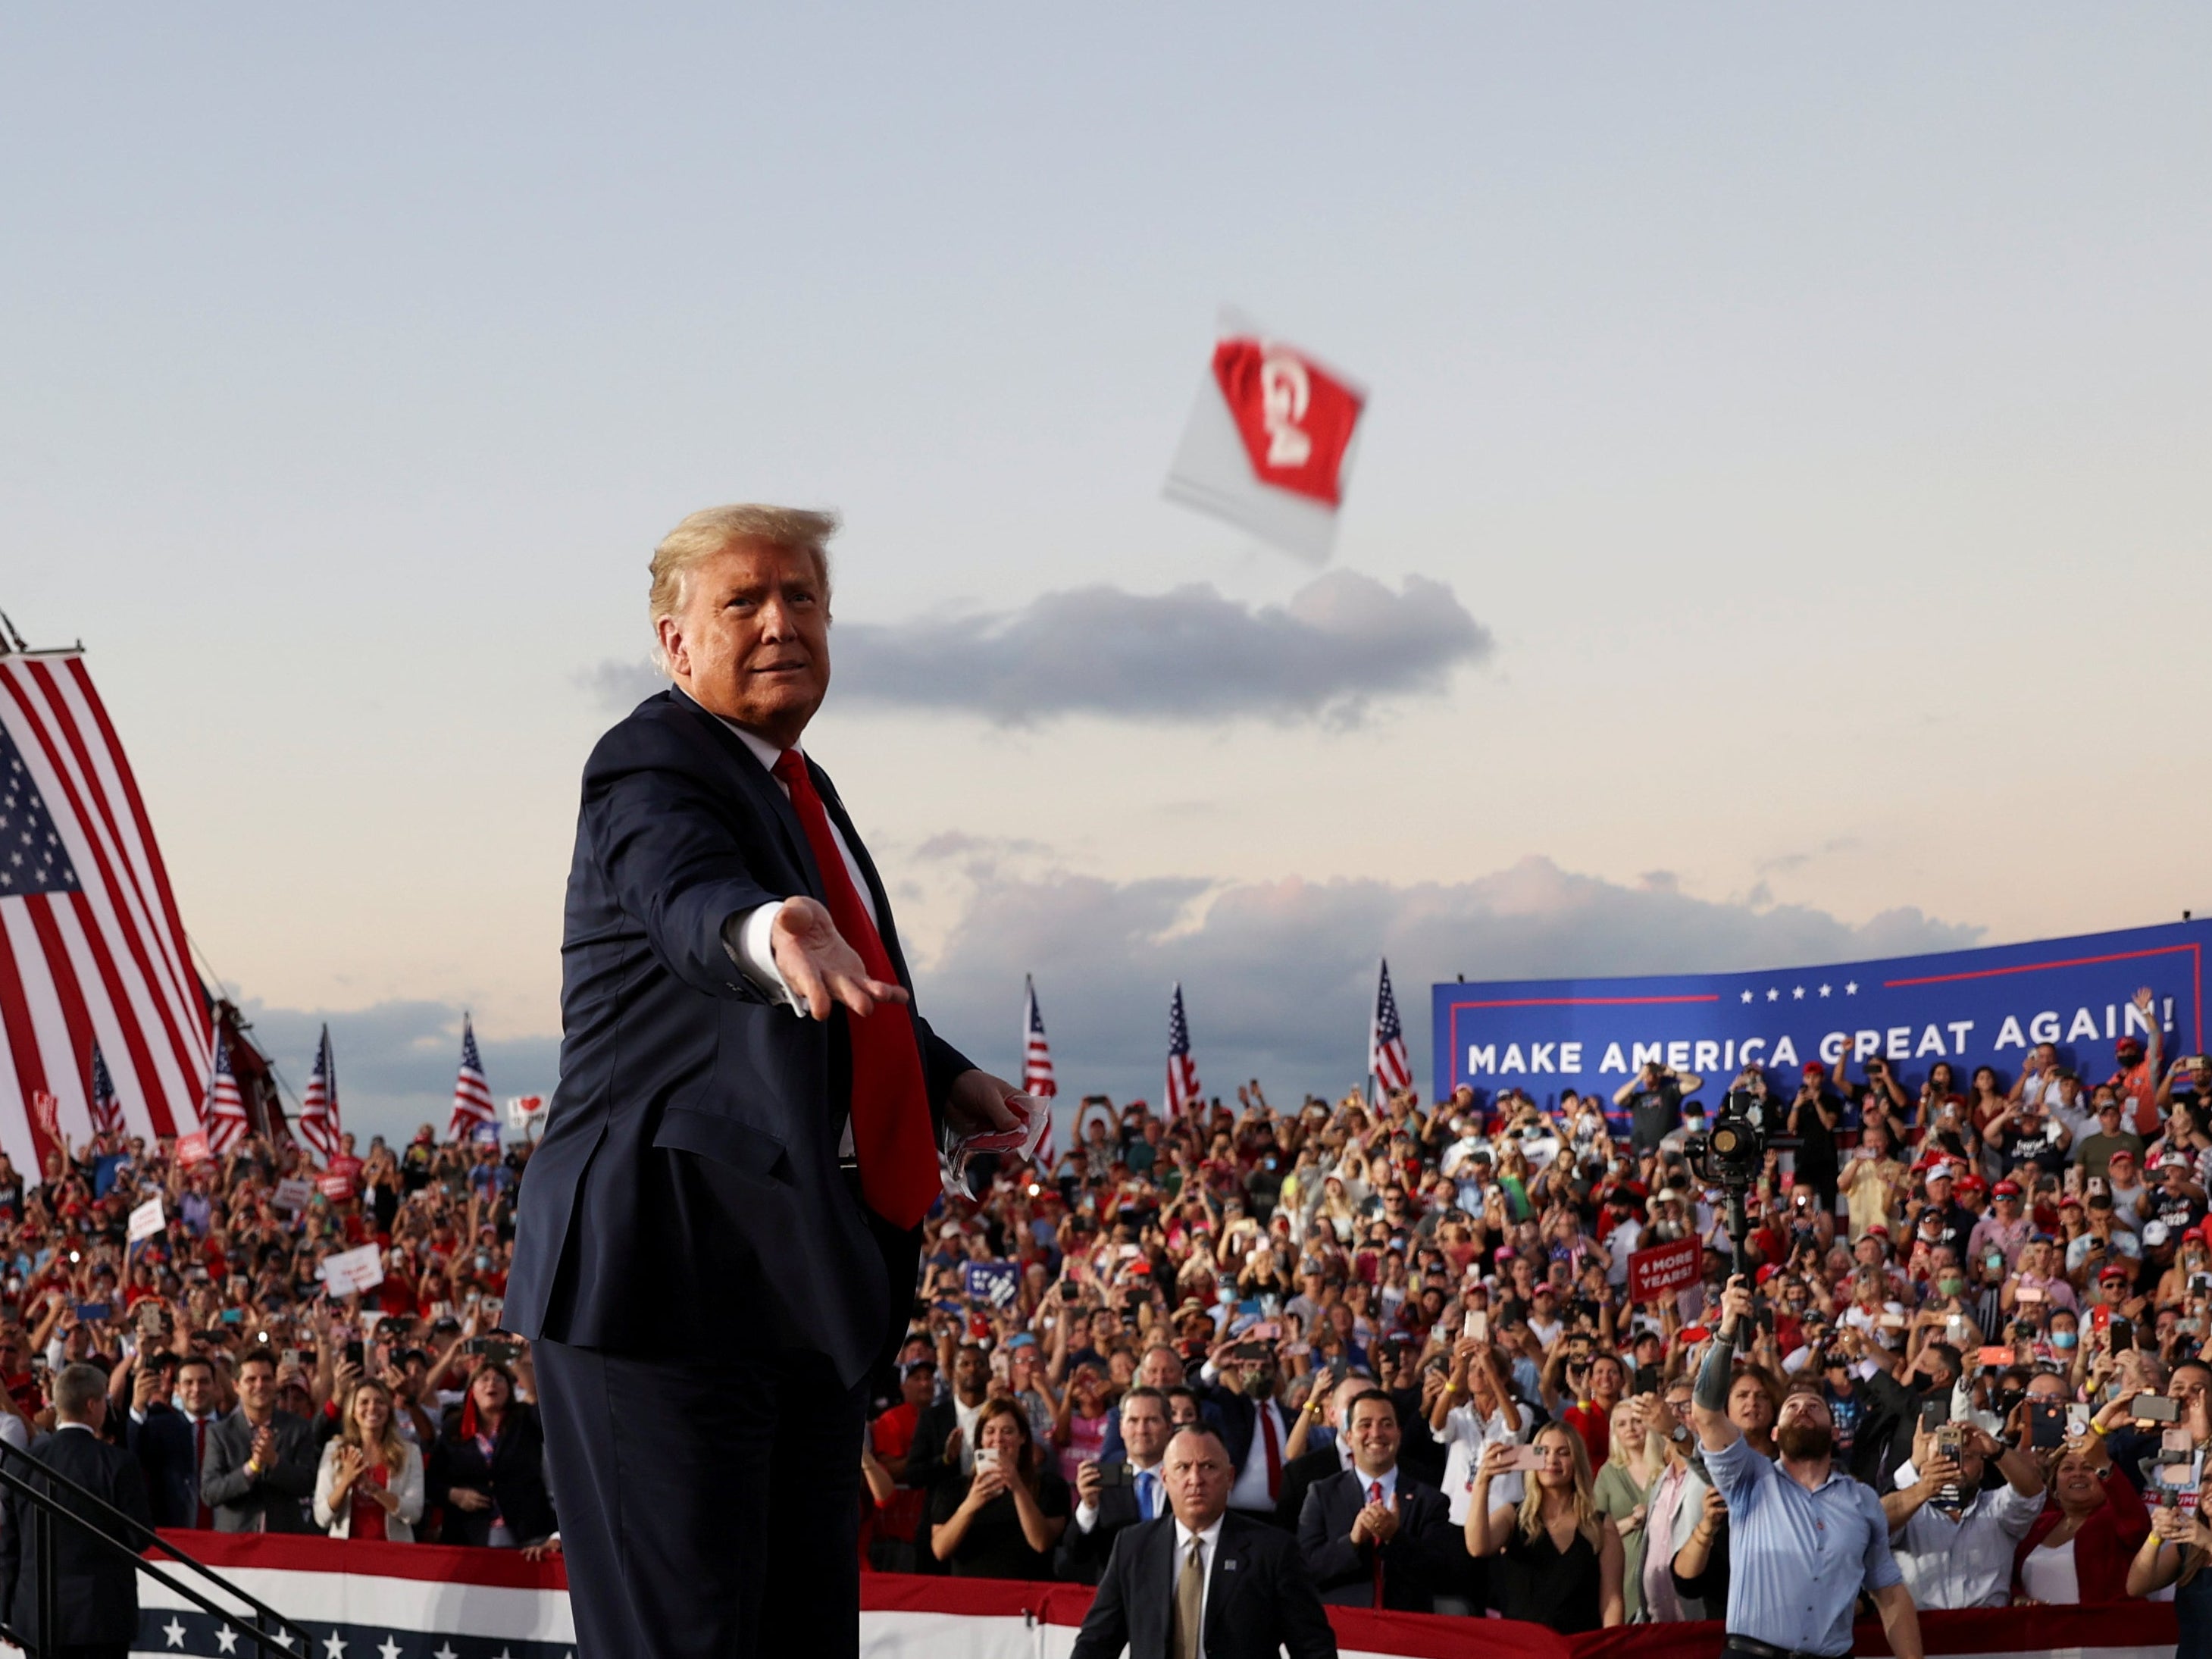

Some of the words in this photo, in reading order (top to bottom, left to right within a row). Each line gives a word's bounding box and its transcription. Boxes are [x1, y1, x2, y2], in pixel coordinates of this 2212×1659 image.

[1468, 1041, 1583, 1075] MAKE
[1598, 1035, 1799, 1074] AMERICA
[1819, 1019, 1975, 1065] GREAT
[1993, 997, 2174, 1051] AGAIN!
[1638, 1262, 1650, 1275] 4
[1652, 1249, 1693, 1273] MORE
[1641, 1264, 1693, 1290] YEARS!
